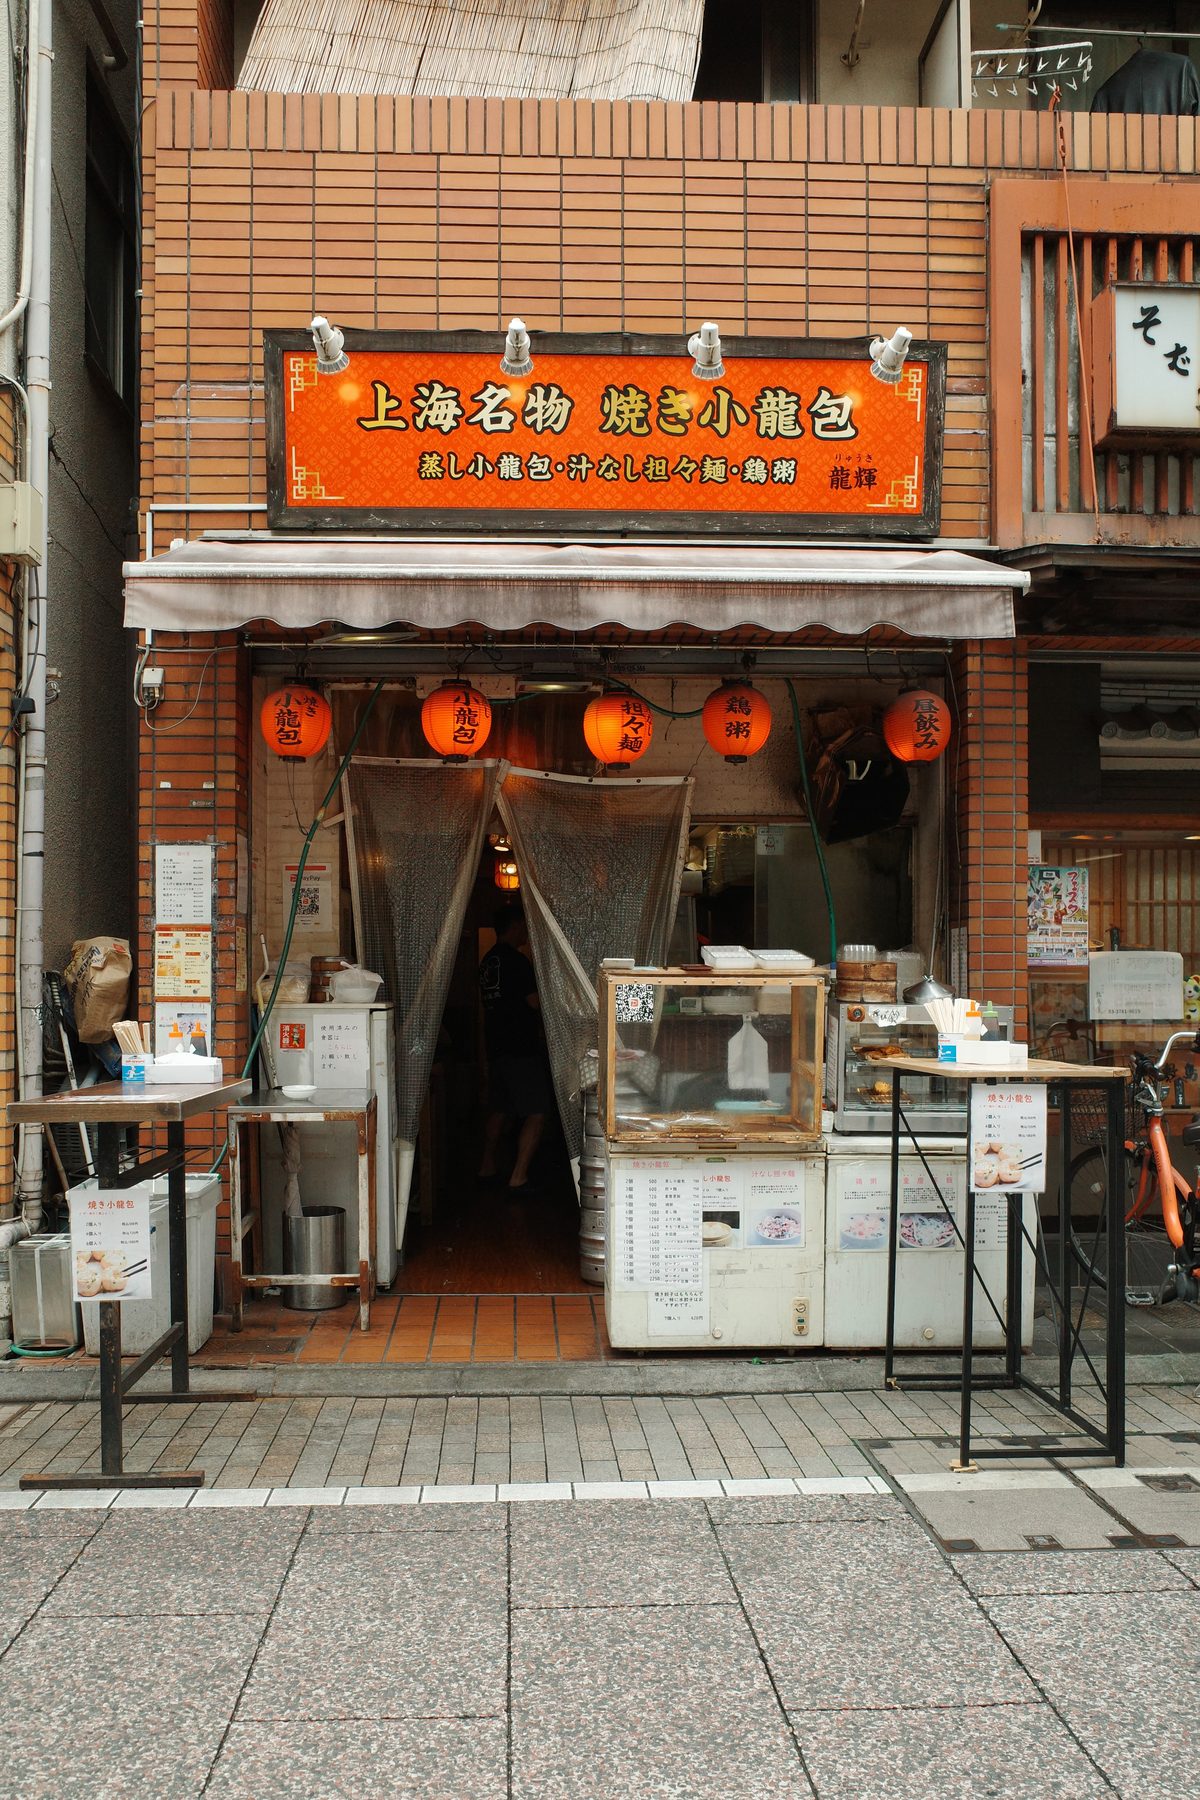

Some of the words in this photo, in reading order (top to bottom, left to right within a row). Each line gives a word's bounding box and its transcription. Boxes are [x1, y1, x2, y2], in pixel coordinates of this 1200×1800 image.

[358, 380, 575, 435] 上海名物
[600, 384, 859, 441] 焼き小龍包
[828, 465, 878, 491] 龍輝
[834, 453, 874, 464] りゅうき
[273, 692, 303, 746] 小龍包
[452, 691, 481, 745] 小龍包
[617, 701, 645, 753] 担々麺
[725, 696, 752, 739] 鶏粥
[912, 698, 941, 750] 昼飲み
[282, 1024, 290, 1045] 消火器
[88, 1200, 135, 1210] 焼き小龍包
